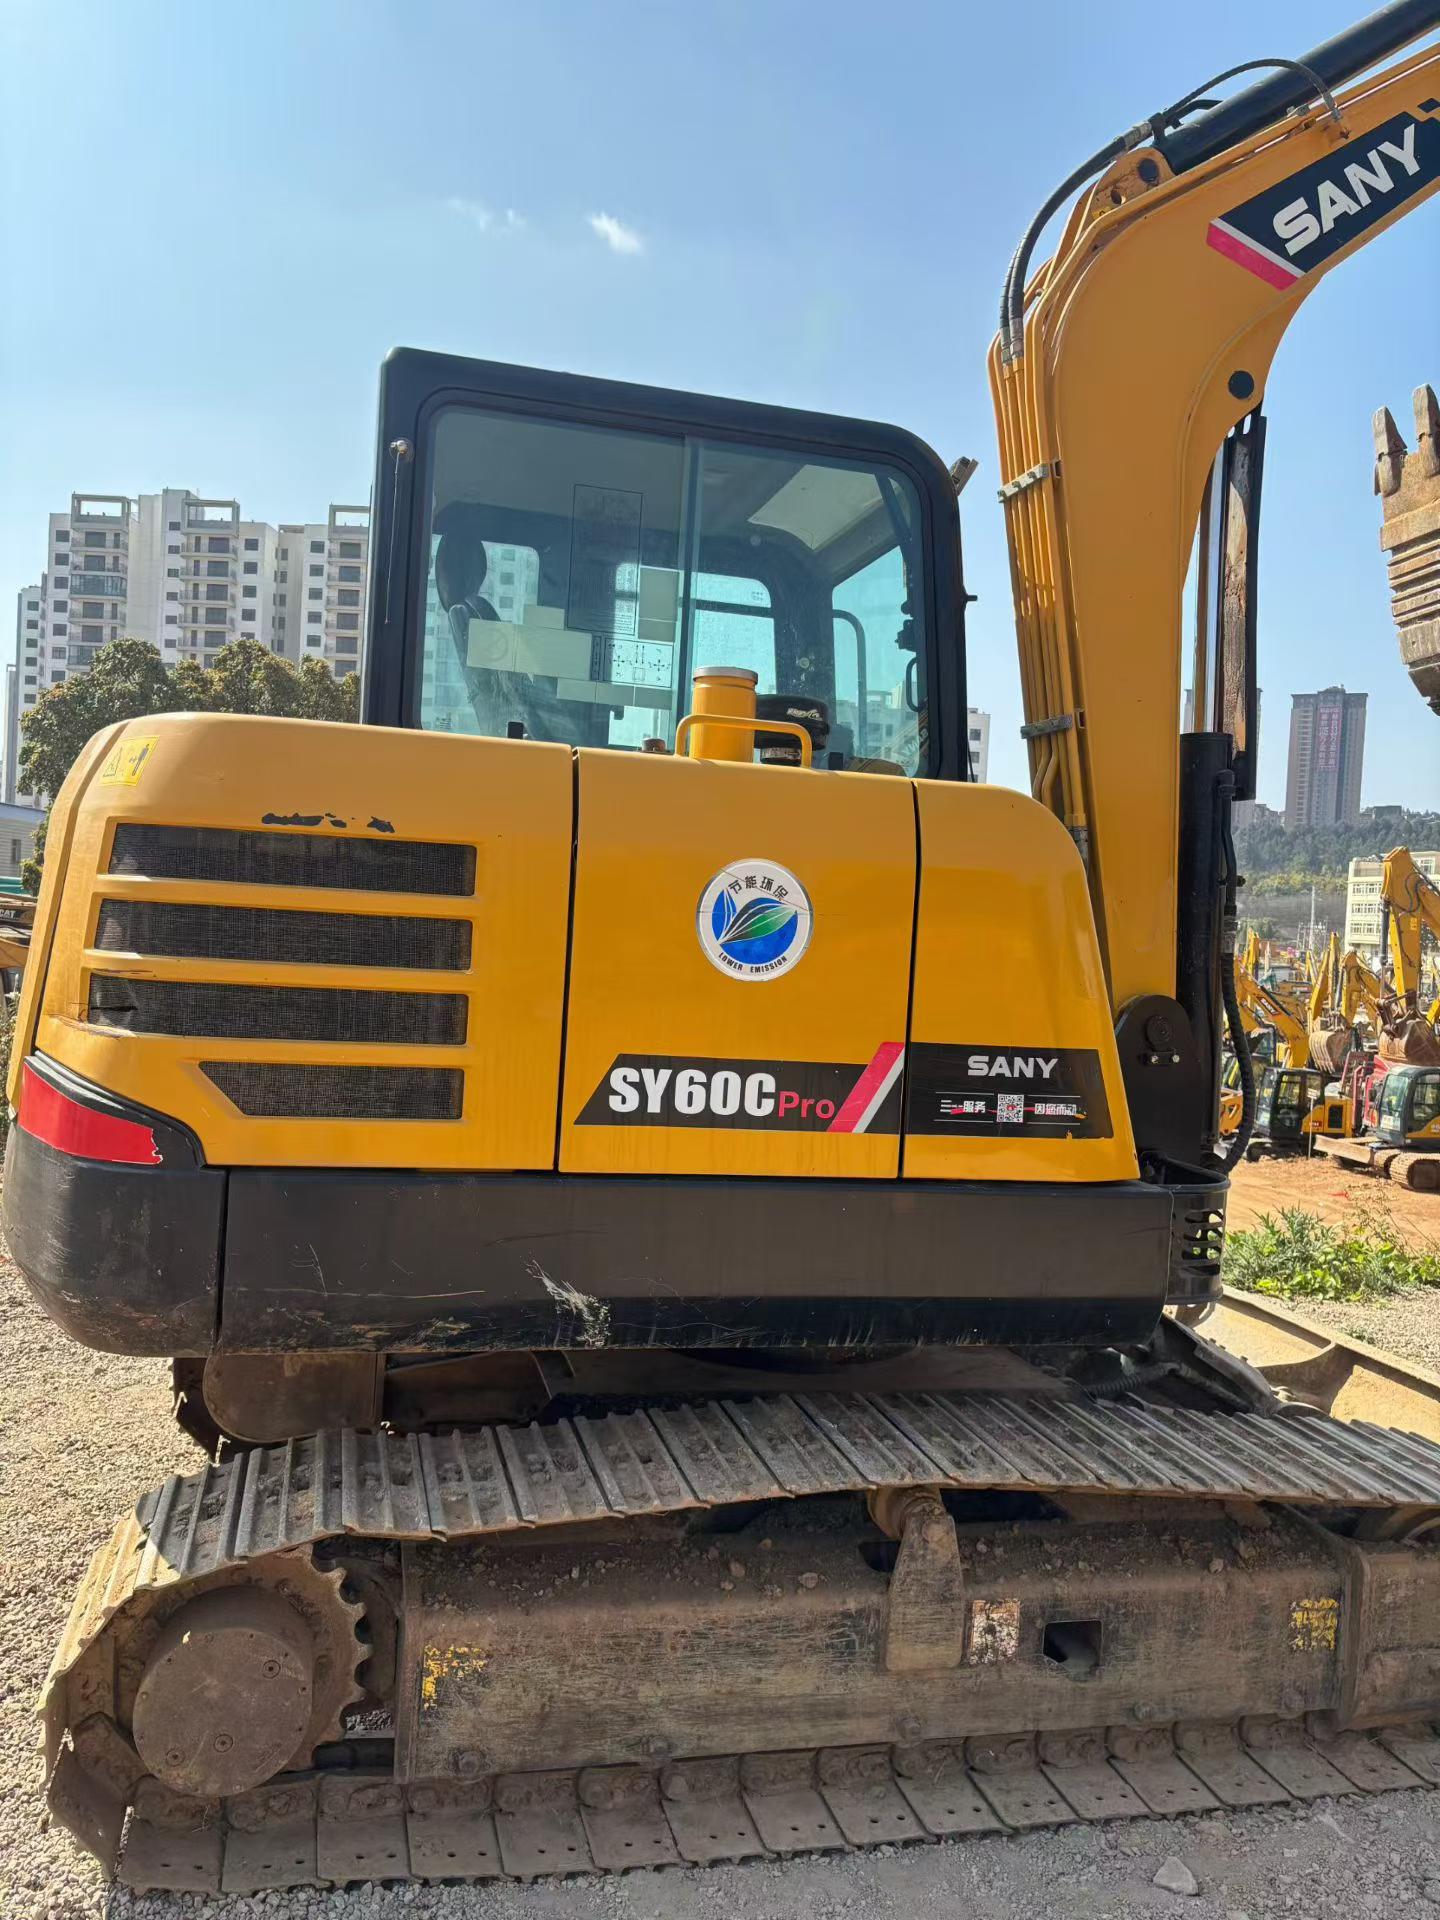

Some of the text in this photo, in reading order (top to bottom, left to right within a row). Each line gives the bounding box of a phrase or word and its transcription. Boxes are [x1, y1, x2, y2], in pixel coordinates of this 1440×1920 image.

[1272, 123, 1421, 256] SANY
[728, 875, 789, 900] 节能环保
[718, 952, 788, 973] LOWER EMISSION
[968, 1055, 1059, 1079] SANY
[609, 1067, 835, 1118] SY60C Pro
